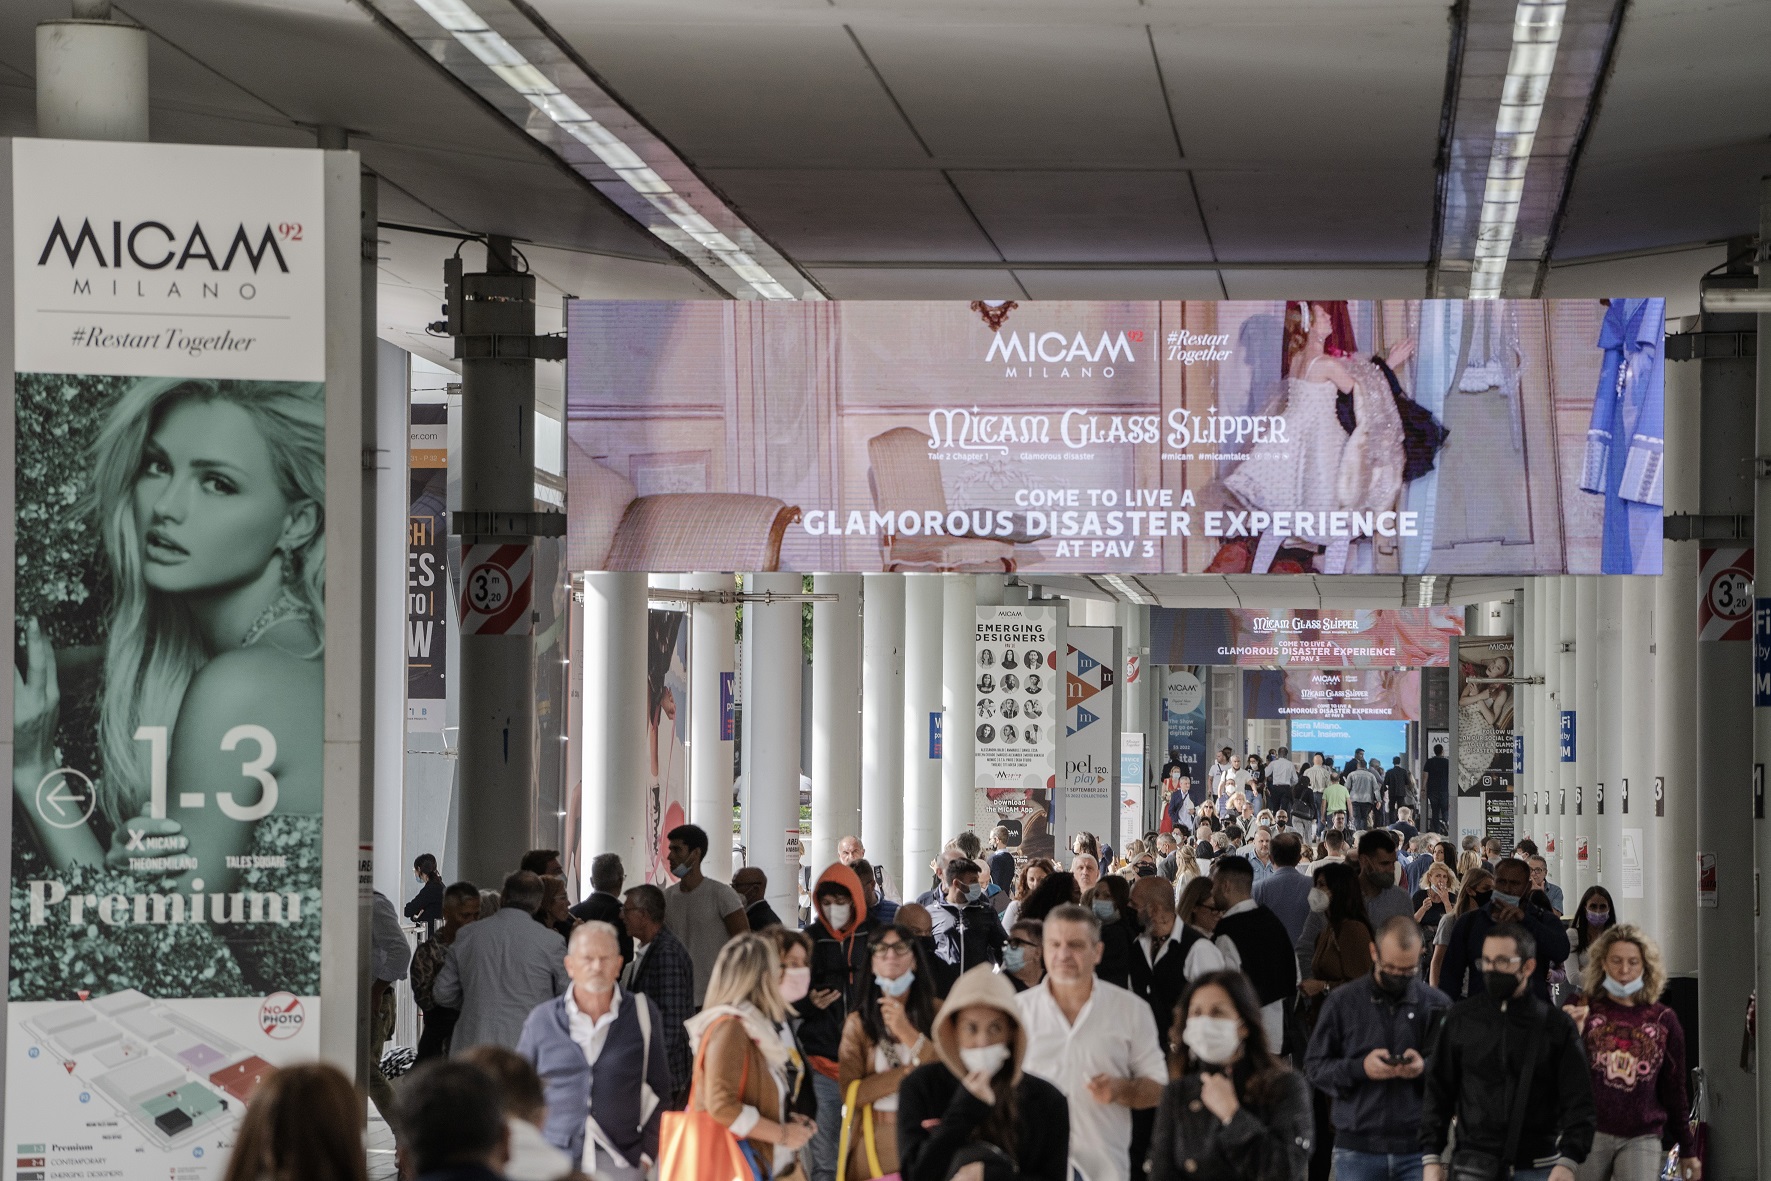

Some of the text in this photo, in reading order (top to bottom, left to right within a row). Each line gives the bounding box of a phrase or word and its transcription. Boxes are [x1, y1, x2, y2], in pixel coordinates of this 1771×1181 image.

[37, 216, 303, 275] MICAM 92
[73, 279, 257, 300] MILANO
[72, 327, 257, 357] #Restart Together
[1167, 330, 1229, 346] #Restart
[985, 330, 1144, 363] MICAM 92
[1167, 344, 1232, 366] Together
[1005, 367, 1115, 378] MILANO
[953, 452, 984, 461] Chapter
[1020, 452, 1095, 461] Glamorous disaster
[1015, 489, 1196, 507] COME TO LIVE A
[802, 510, 1419, 537] GLAMOROUS DISASTER EXPERIENCE
[1055, 540, 1155, 558] AT PAV 3
[475, 575, 488, 602] 3
[1719, 581, 1733, 608] 3
[977, 624, 1042, 632] EMERGING
[976, 634, 1045, 642] DESIGNERS
[1217, 647, 1396, 655] GLAMOROUS DISASTER EXPERIENCE
[1080, 659, 1092, 667] m
[1079, 713, 1092, 722] m
[1291, 730, 1351, 738] Sicuri. Insieme.
[1074, 773, 1096, 785] play
[1576, 788, 1581, 803] 6
[1597, 786, 1603, 801] 5
[1622, 780, 1627, 799] 4
[1655, 778, 1662, 800] 3
[128, 855, 287, 871] THEONEMILANO TALES SQUARE
[27, 878, 302, 926] Premium
[264, 1005, 281, 1014] NO
[264, 1014, 302, 1023] PHOTO
[52, 1143, 93, 1152] Premium
[50, 1157, 107, 1166] CONTEMPORARY
[50, 1171, 84, 1179] EMERGING
[87, 1170, 124, 1178] DESIGNERS
